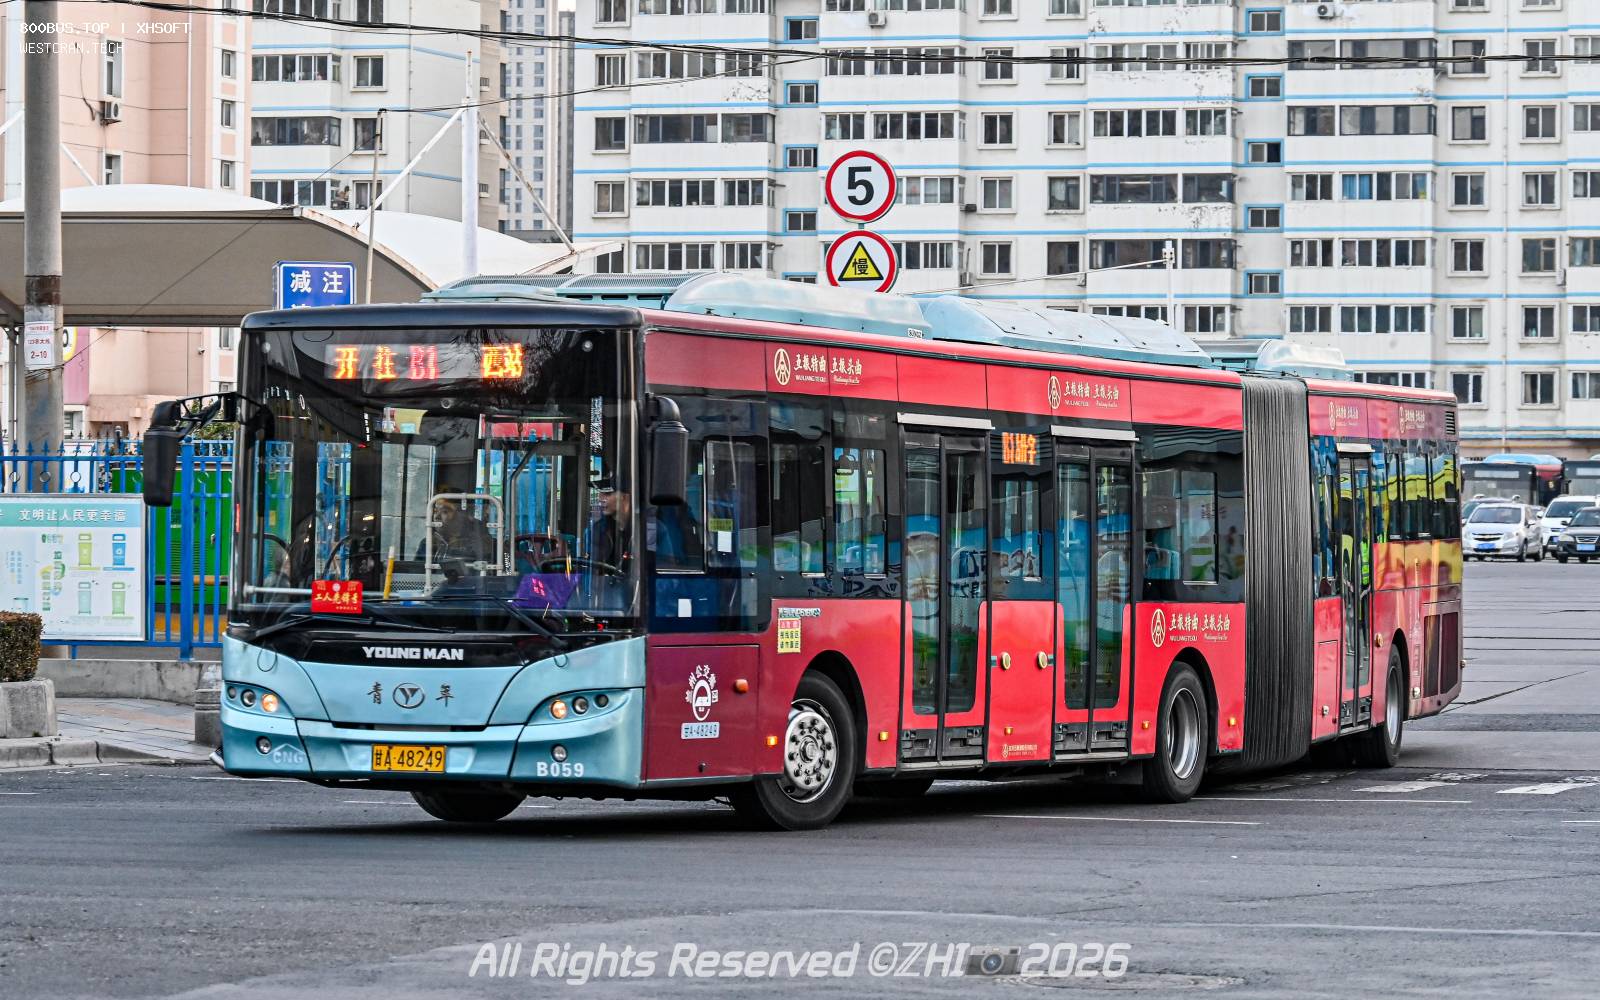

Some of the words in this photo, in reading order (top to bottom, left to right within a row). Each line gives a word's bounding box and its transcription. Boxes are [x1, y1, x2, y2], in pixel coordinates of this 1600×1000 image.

[847, 166, 875, 206] 5
[852, 258, 869, 275] 慢
[19, 508, 127, 522] 文明让人民更幸福
[362, 646, 421, 660] YOUNG
[423, 647, 464, 661] MAN
[273, 751, 304, 764] CNG
[536, 761, 585, 778] B059
